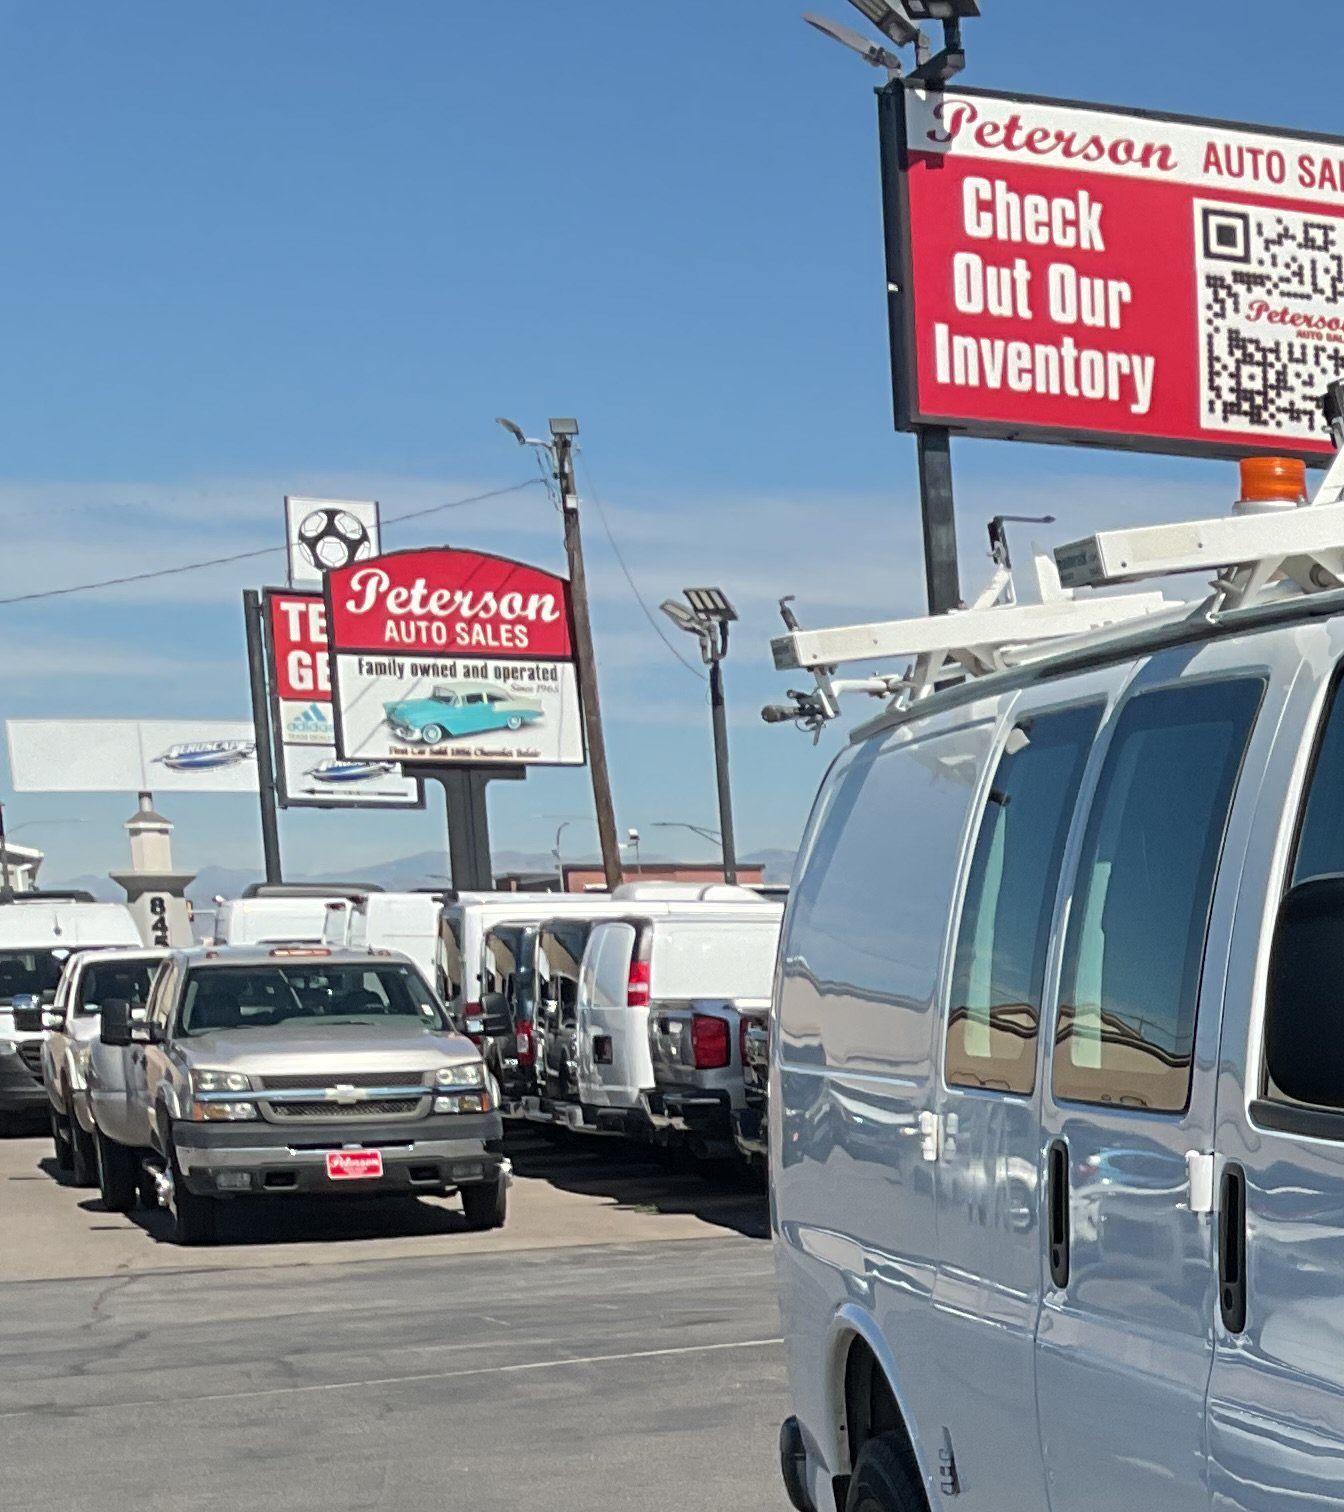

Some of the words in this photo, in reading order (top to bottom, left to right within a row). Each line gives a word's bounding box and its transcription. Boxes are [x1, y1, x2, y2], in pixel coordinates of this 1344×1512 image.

[926, 99, 1178, 171] Peterson
[1203, 141, 1286, 184] AUTO
[962, 176, 1105, 251] Check
[953, 252, 1032, 319] Out
[1048, 262, 1132, 329] Our
[1296, 330, 1323, 341] AUTO
[934, 323, 1155, 414] Inventory
[346, 568, 560, 622] Peterson
[280, 601, 328, 643] TE
[384, 619, 447, 645] AUTO
[455, 622, 529, 648] SALES
[287, 649, 331, 691] GE
[358, 657, 405, 680] Family
[410, 660, 457, 679] owned
[463, 661, 488, 680] and
[493, 663, 558, 683] operated
